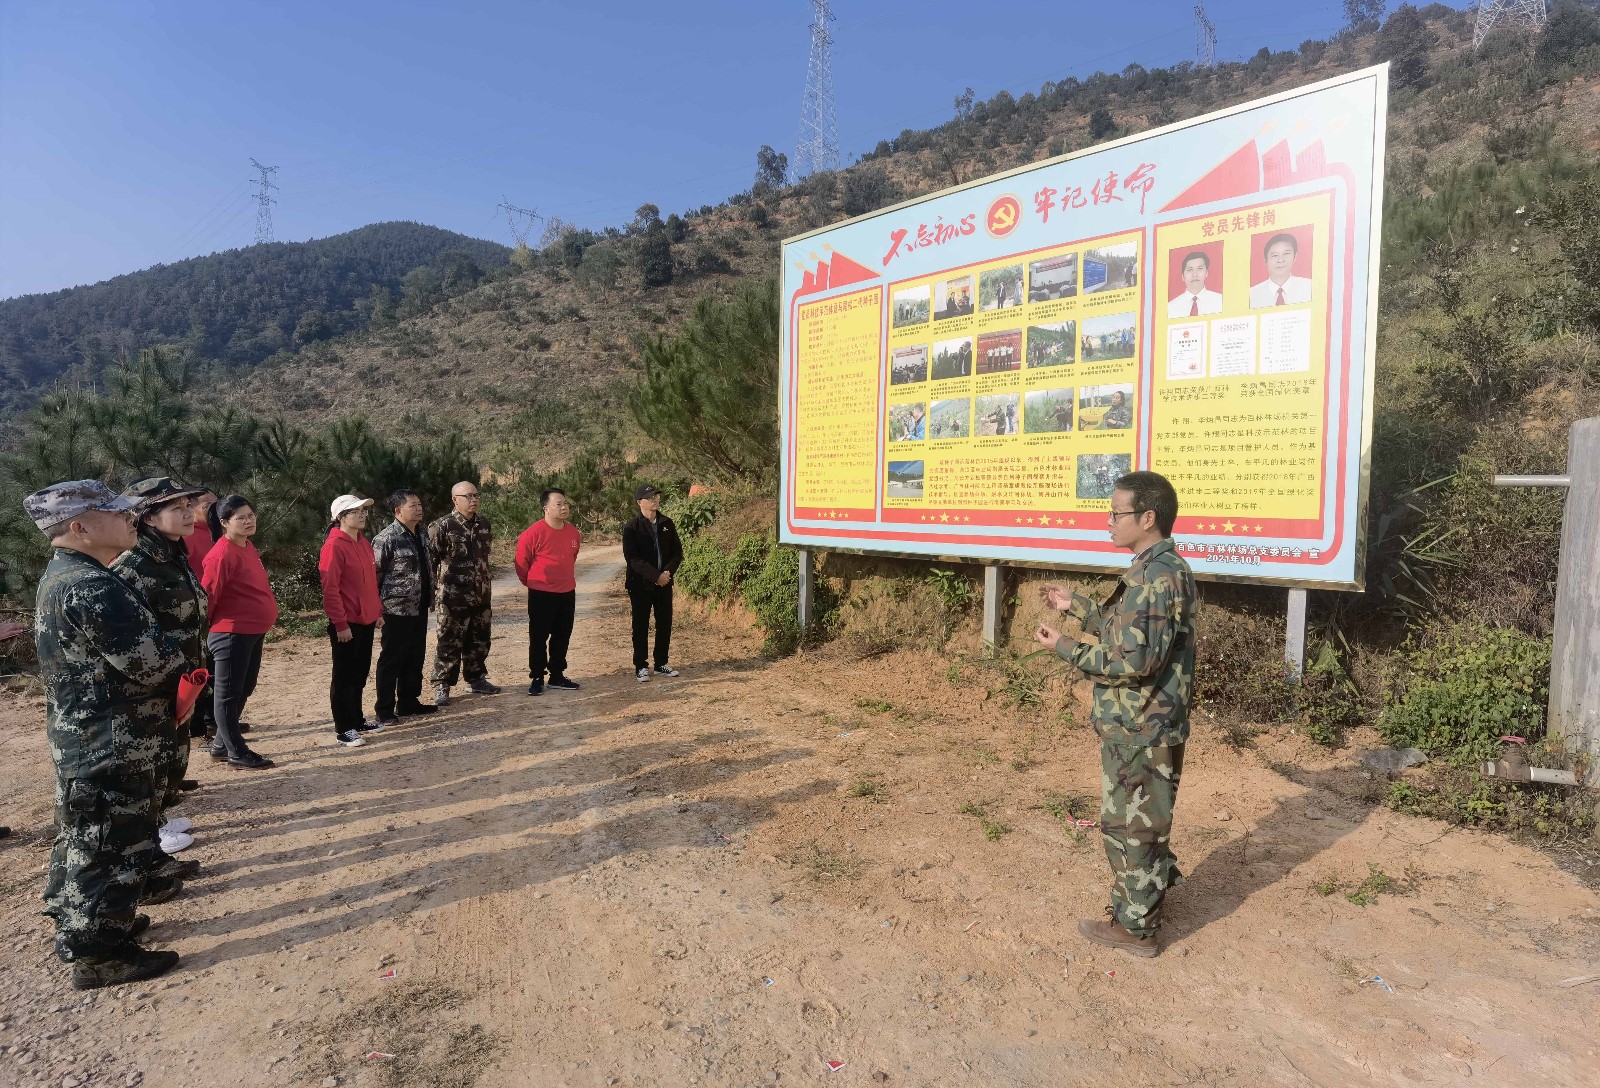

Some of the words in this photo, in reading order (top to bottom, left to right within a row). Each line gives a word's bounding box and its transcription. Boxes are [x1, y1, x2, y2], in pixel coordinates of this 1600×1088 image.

[1033, 163, 1157, 224] 牢记使命
[883, 213, 976, 266] 不忘初心
[1202, 209, 1276, 237] 党员先锋岗
[1206, 554, 1261, 566] 2021年10月
